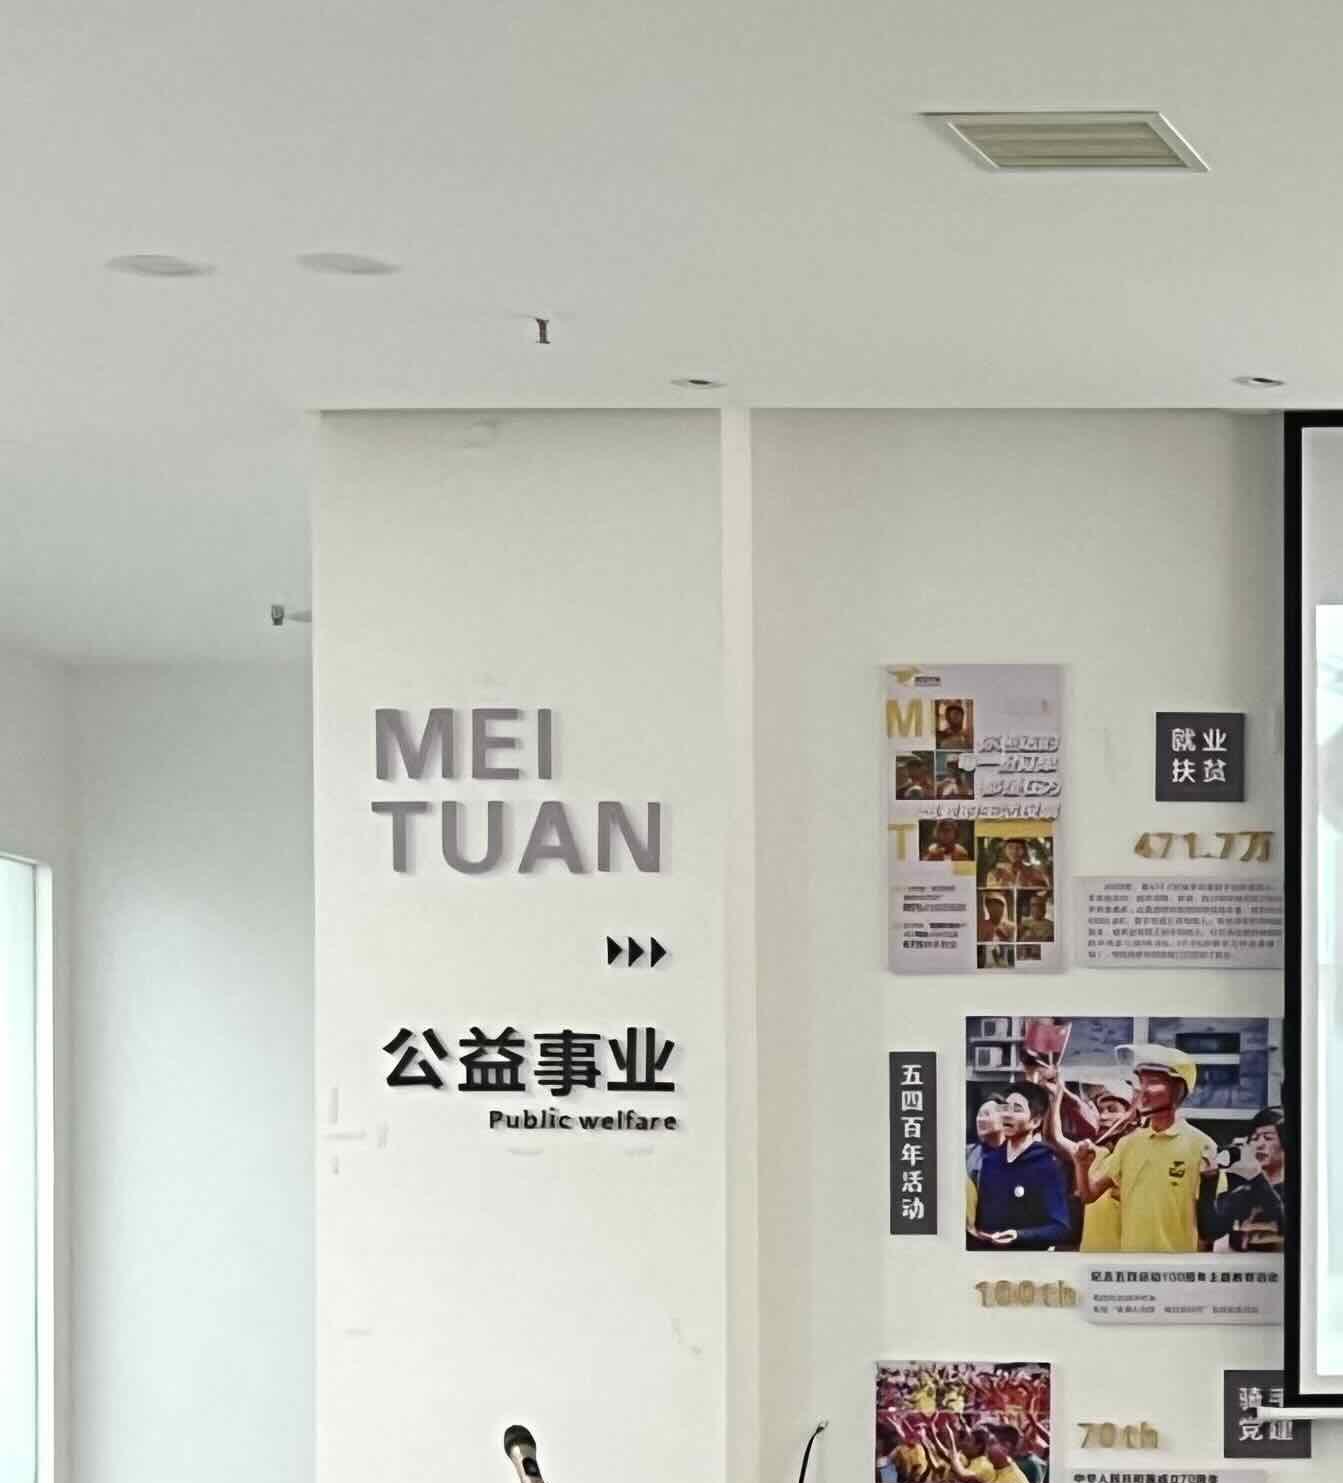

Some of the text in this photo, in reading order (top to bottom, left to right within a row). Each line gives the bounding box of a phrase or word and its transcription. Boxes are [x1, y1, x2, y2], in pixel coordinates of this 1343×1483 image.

[375, 708, 553, 780] MEI
[1171, 727, 1229, 753] 就业
[1171, 758, 1228, 784] 扶贫
[371, 800, 662, 874] TUAN
[382, 1026, 676, 1097] 公益事业
[488, 1107, 678, 1132] Public welfare
[900, 1064, 925, 1221] 五四百年活动
